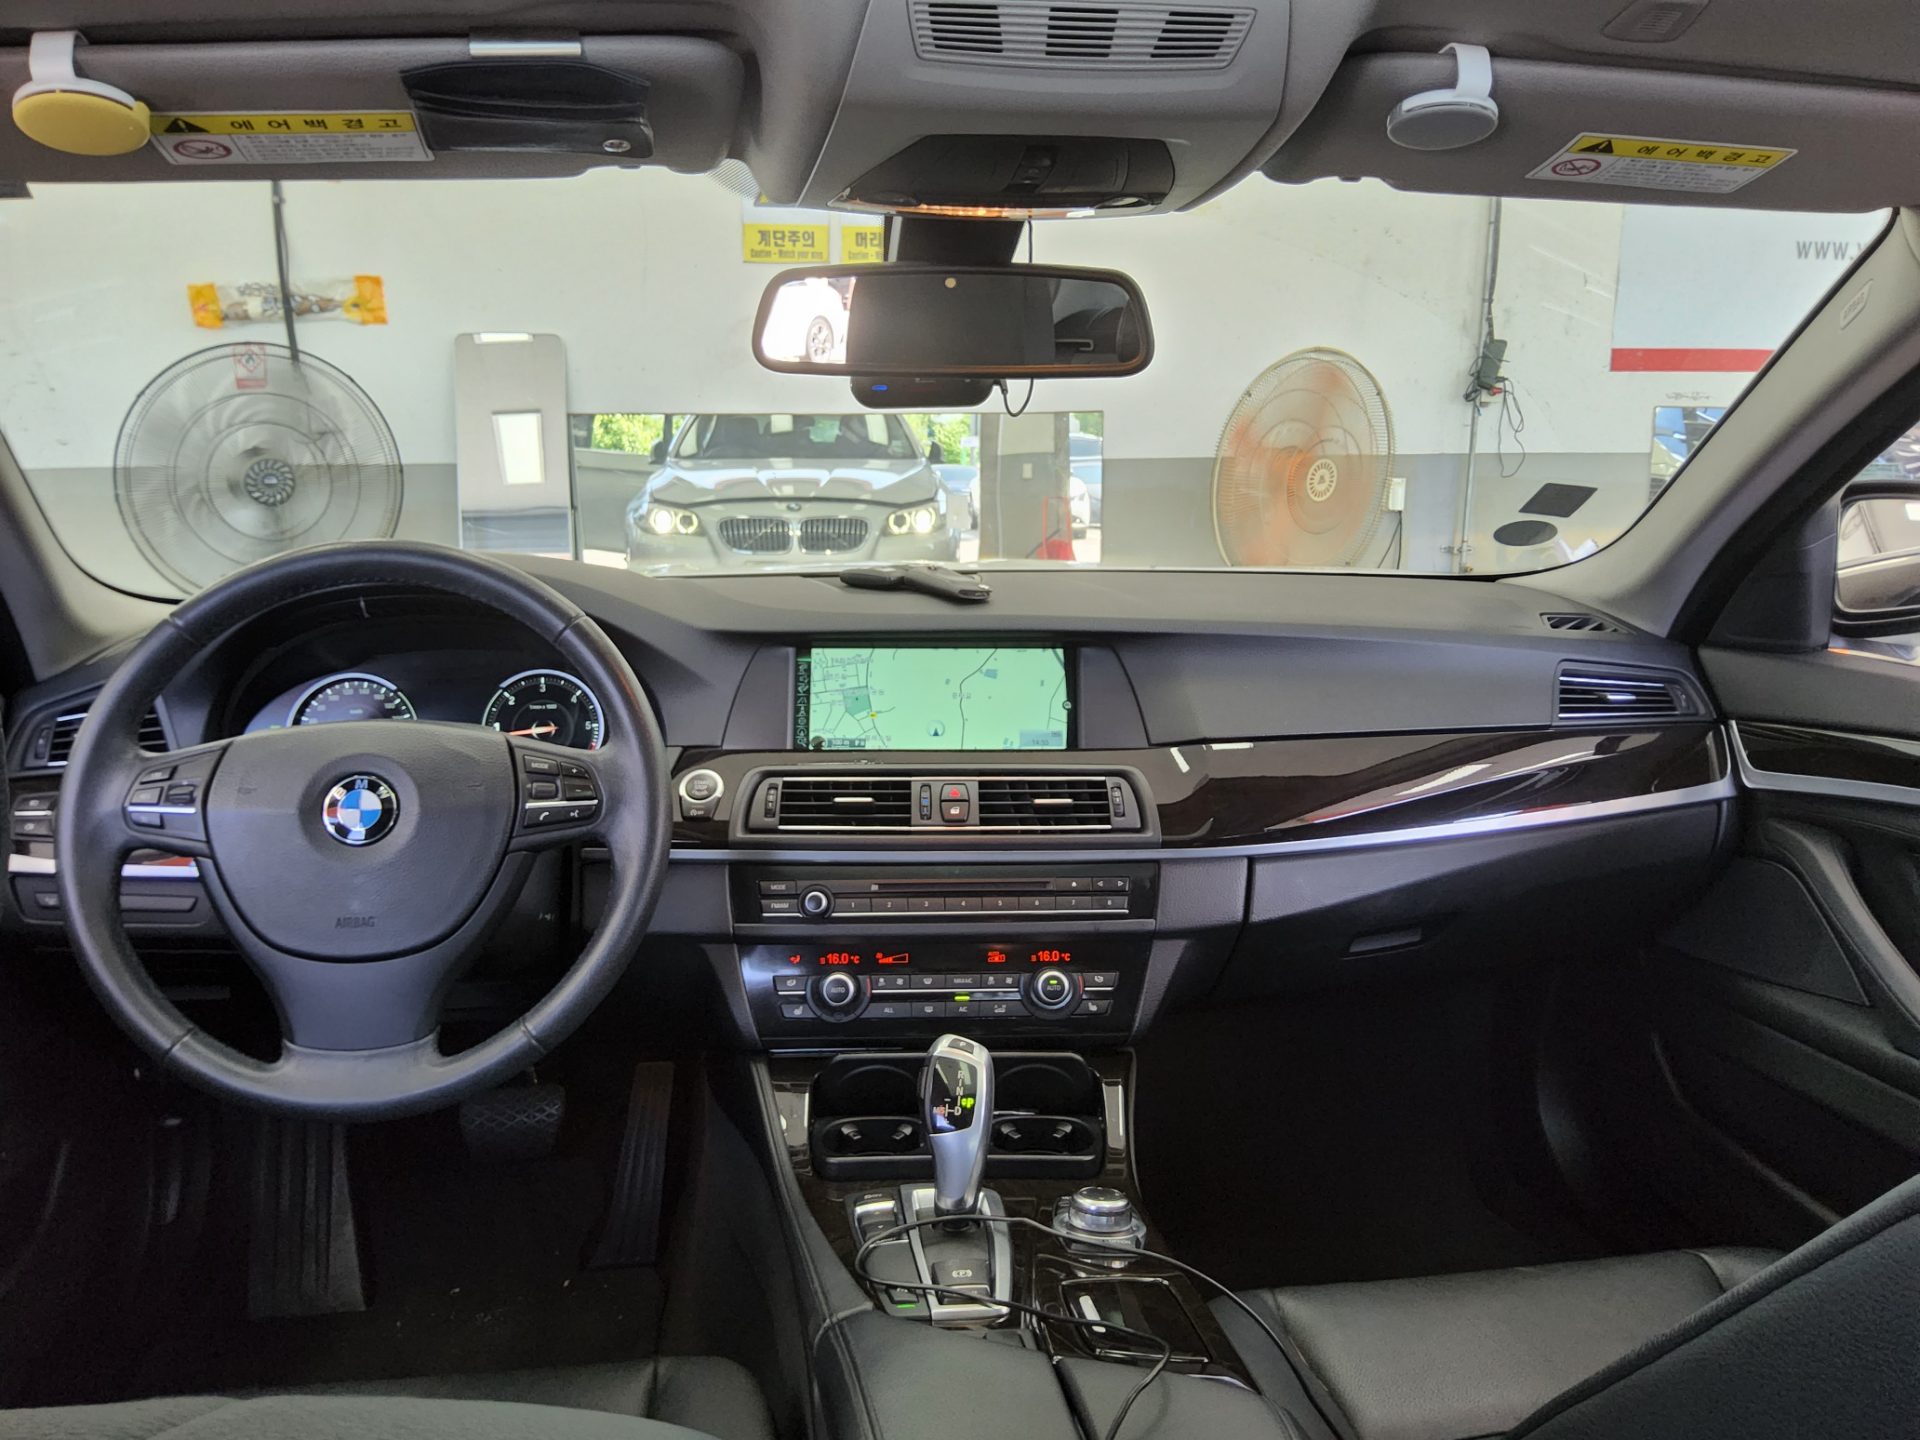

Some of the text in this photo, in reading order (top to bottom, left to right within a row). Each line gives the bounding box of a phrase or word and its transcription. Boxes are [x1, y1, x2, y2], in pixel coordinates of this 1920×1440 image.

[757, 229, 815, 248] 계단주의
[539, 684, 547, 693] 3
[508, 696, 516, 705] 2
[570, 695, 577, 703] 4
[585, 720, 592, 730] 5
[333, 779, 391, 800] BMW
[334, 915, 376, 929] AIRBAG
[826, 952, 849, 965] 16.0
[1037, 950, 1060, 963] 16.0
[830, 985, 846, 993] AUTO
[884, 1006, 893, 1014] ALL
[958, 1005, 968, 1013] AC
[957, 1070, 964, 1079] R
[956, 1086, 963, 1096] N
[954, 1106, 962, 1116] D
